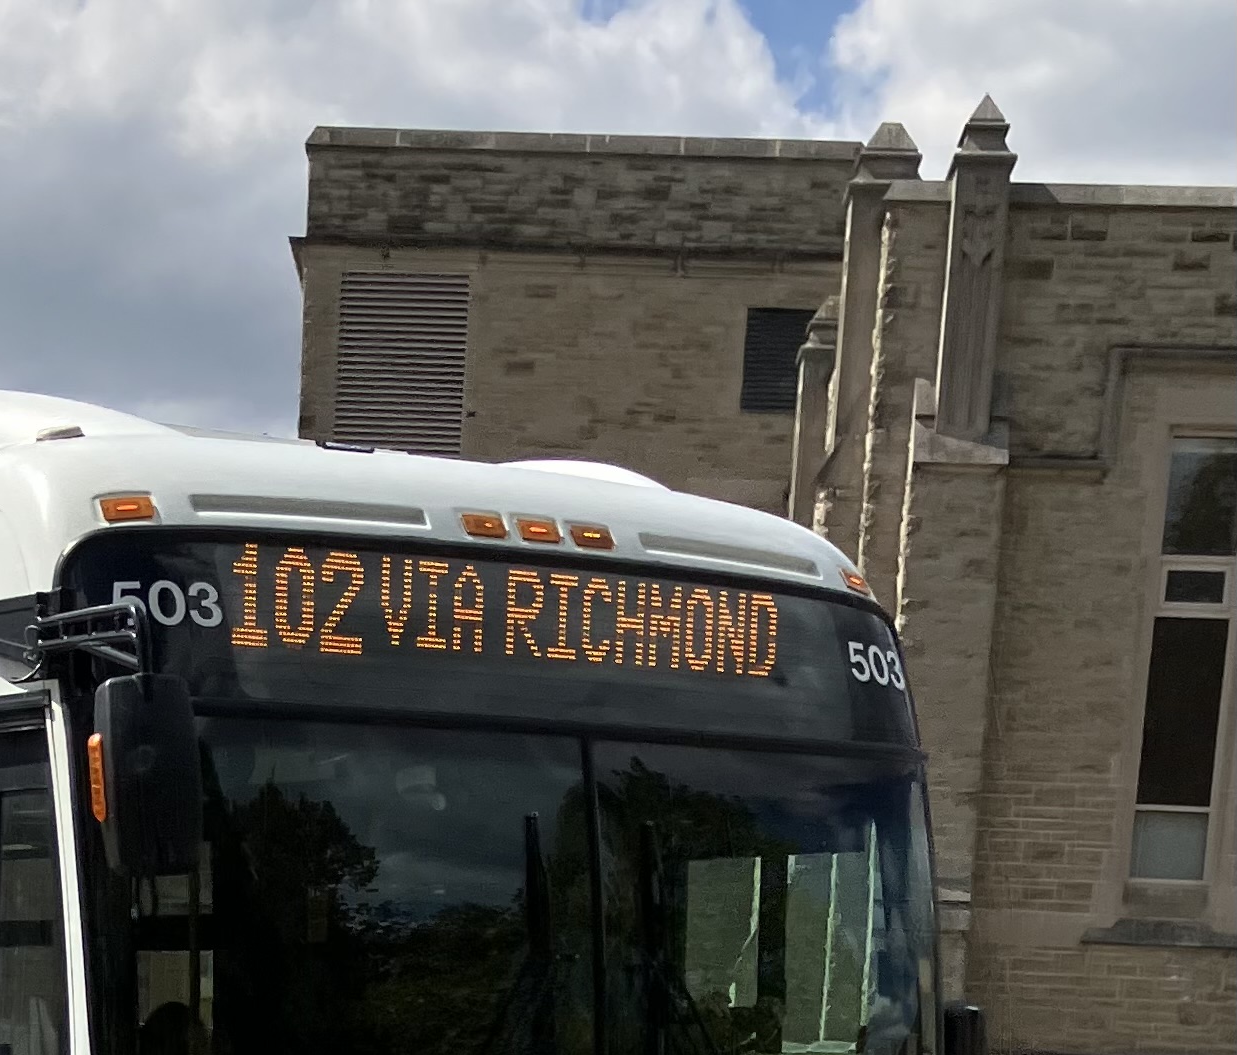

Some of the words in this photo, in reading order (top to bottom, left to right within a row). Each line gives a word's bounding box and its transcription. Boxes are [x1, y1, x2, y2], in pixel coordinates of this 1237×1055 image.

[231, 542, 365, 655] 102
[380, 555, 485, 653] VIA
[504, 569, 778, 676] RICHMOND
[848, 641, 905, 691] 503
